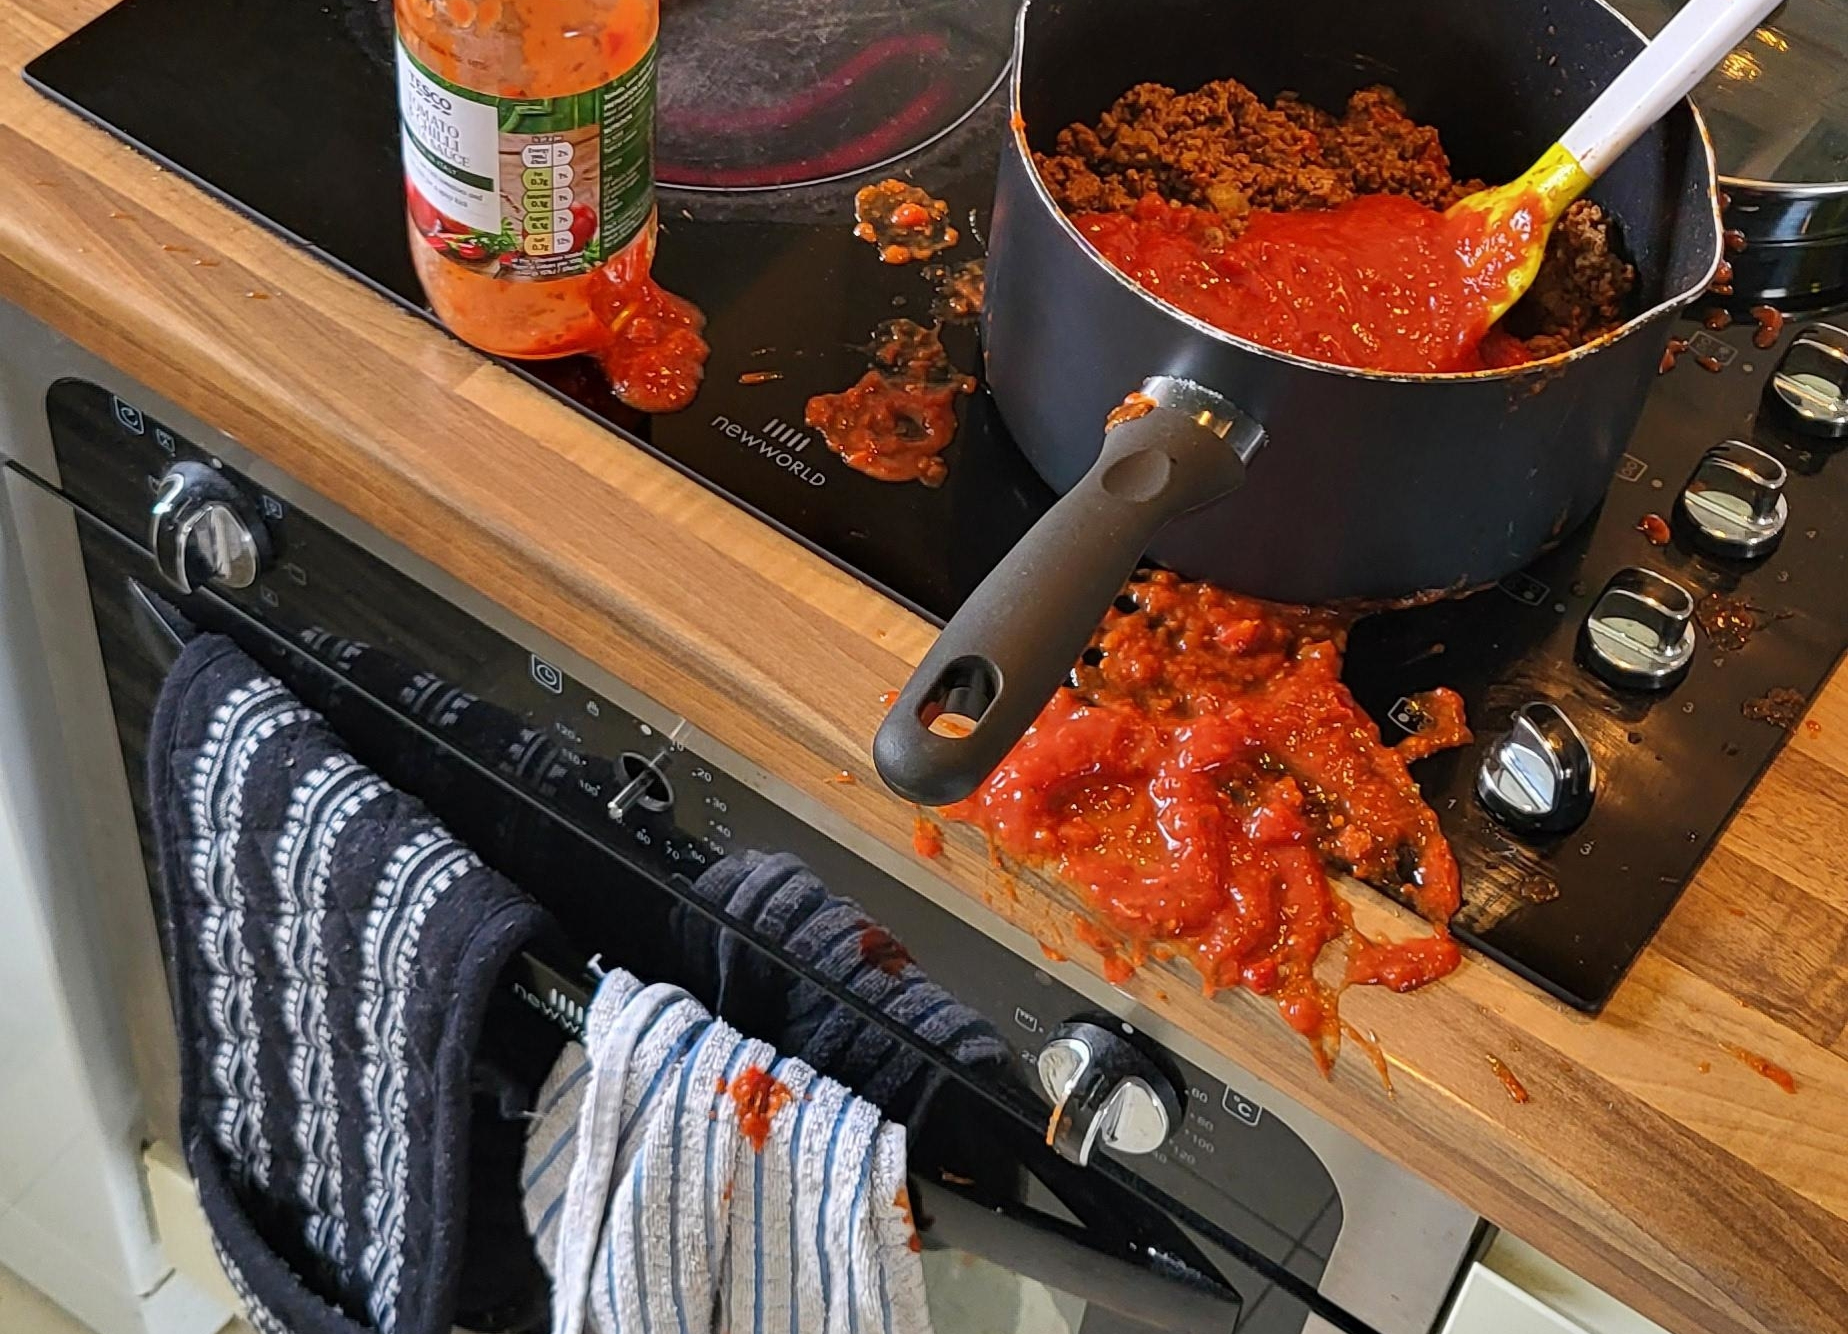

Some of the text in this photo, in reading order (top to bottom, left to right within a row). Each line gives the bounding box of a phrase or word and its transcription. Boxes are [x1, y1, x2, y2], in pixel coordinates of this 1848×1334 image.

[408, 70, 453, 114] TESCO
[430, 138, 472, 168] SAUCE
[1806, 529, 1817, 539] 4
[1776, 570, 1789, 582] 3
[1682, 702, 1694, 714] 3
[555, 722, 576, 740] 120
[697, 767, 713, 783] 20
[579, 778, 599, 797] 100
[713, 796, 728, 813] 30
[1447, 798, 1457, 809] 1
[716, 824, 731, 838] 40
[665, 845, 681, 860] 70
[709, 841, 725, 856] 50
[1503, 844, 1518, 858] 2
[1579, 842, 1593, 856] 3
[1233, 1094, 1253, 1118] °C
[1193, 1133, 1215, 1154] 100
[1174, 1146, 1196, 1165] 120
